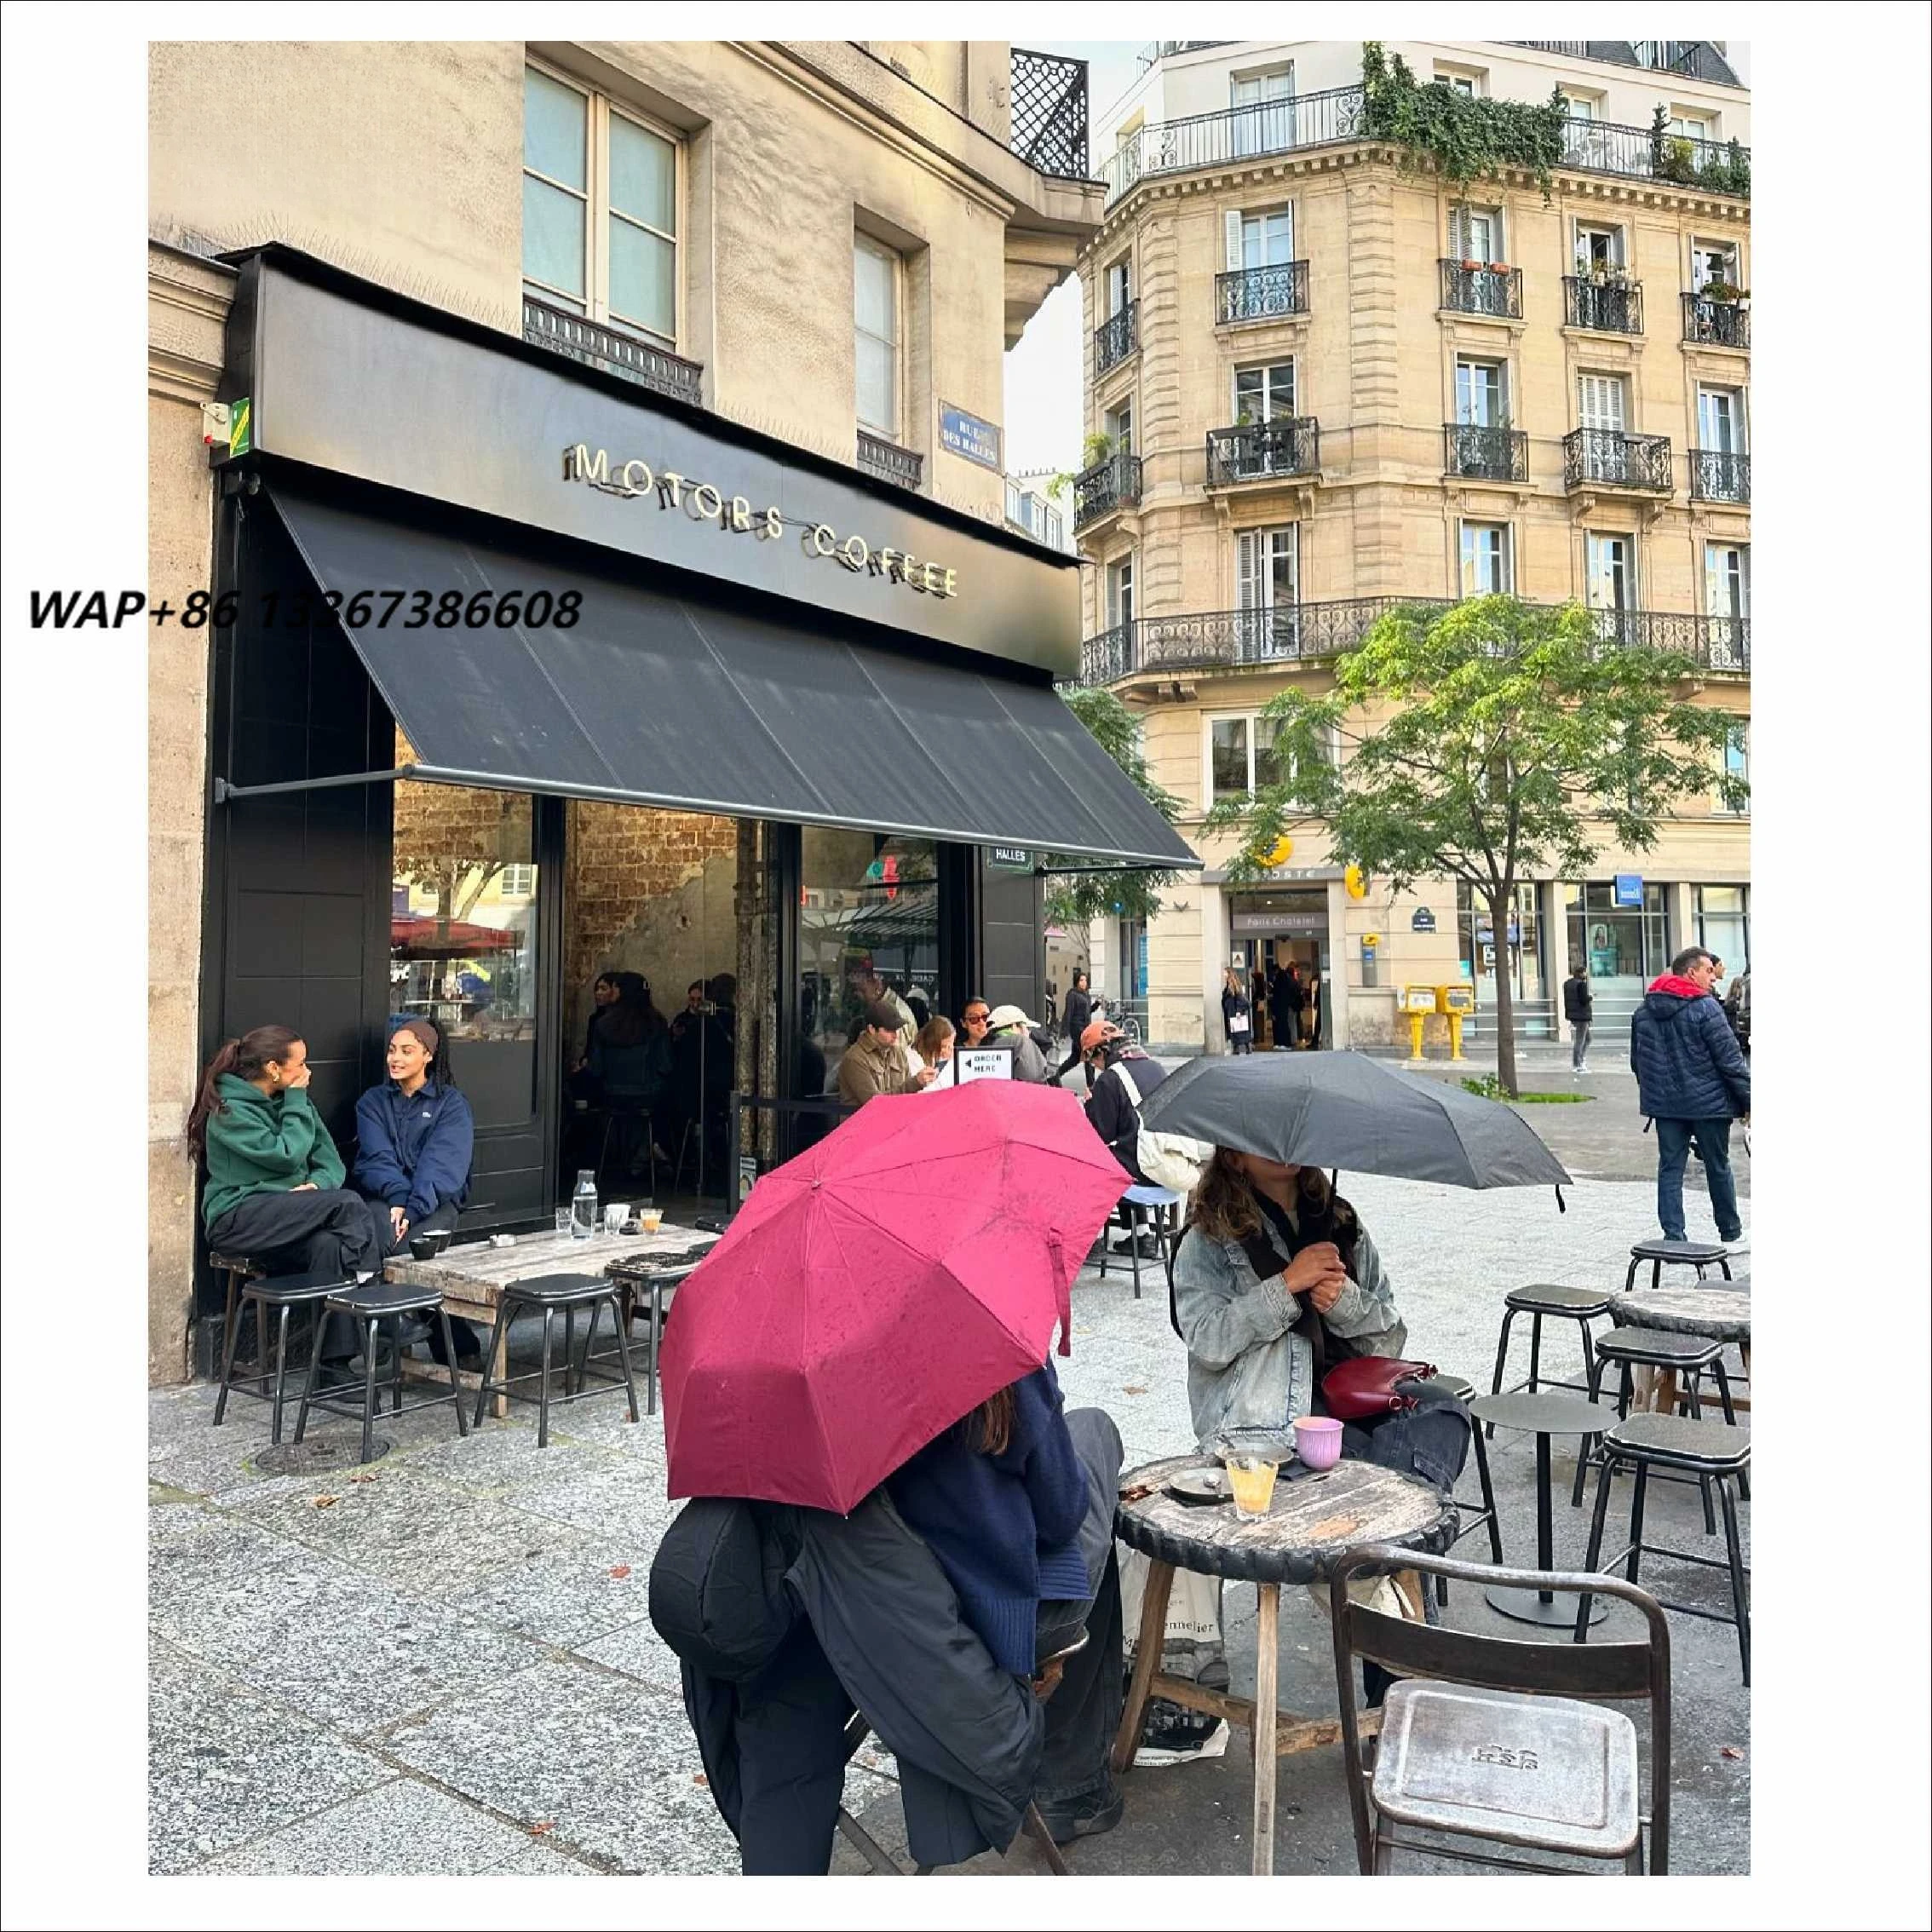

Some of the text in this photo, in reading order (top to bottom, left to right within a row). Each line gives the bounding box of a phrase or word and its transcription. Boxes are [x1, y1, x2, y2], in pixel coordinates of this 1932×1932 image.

[943, 429, 961, 446] DES
[575, 444, 957, 597] MOTORS COFFEE
[996, 848, 1026, 862] HALLES
[1164, 1621, 1214, 1633] ennelier
